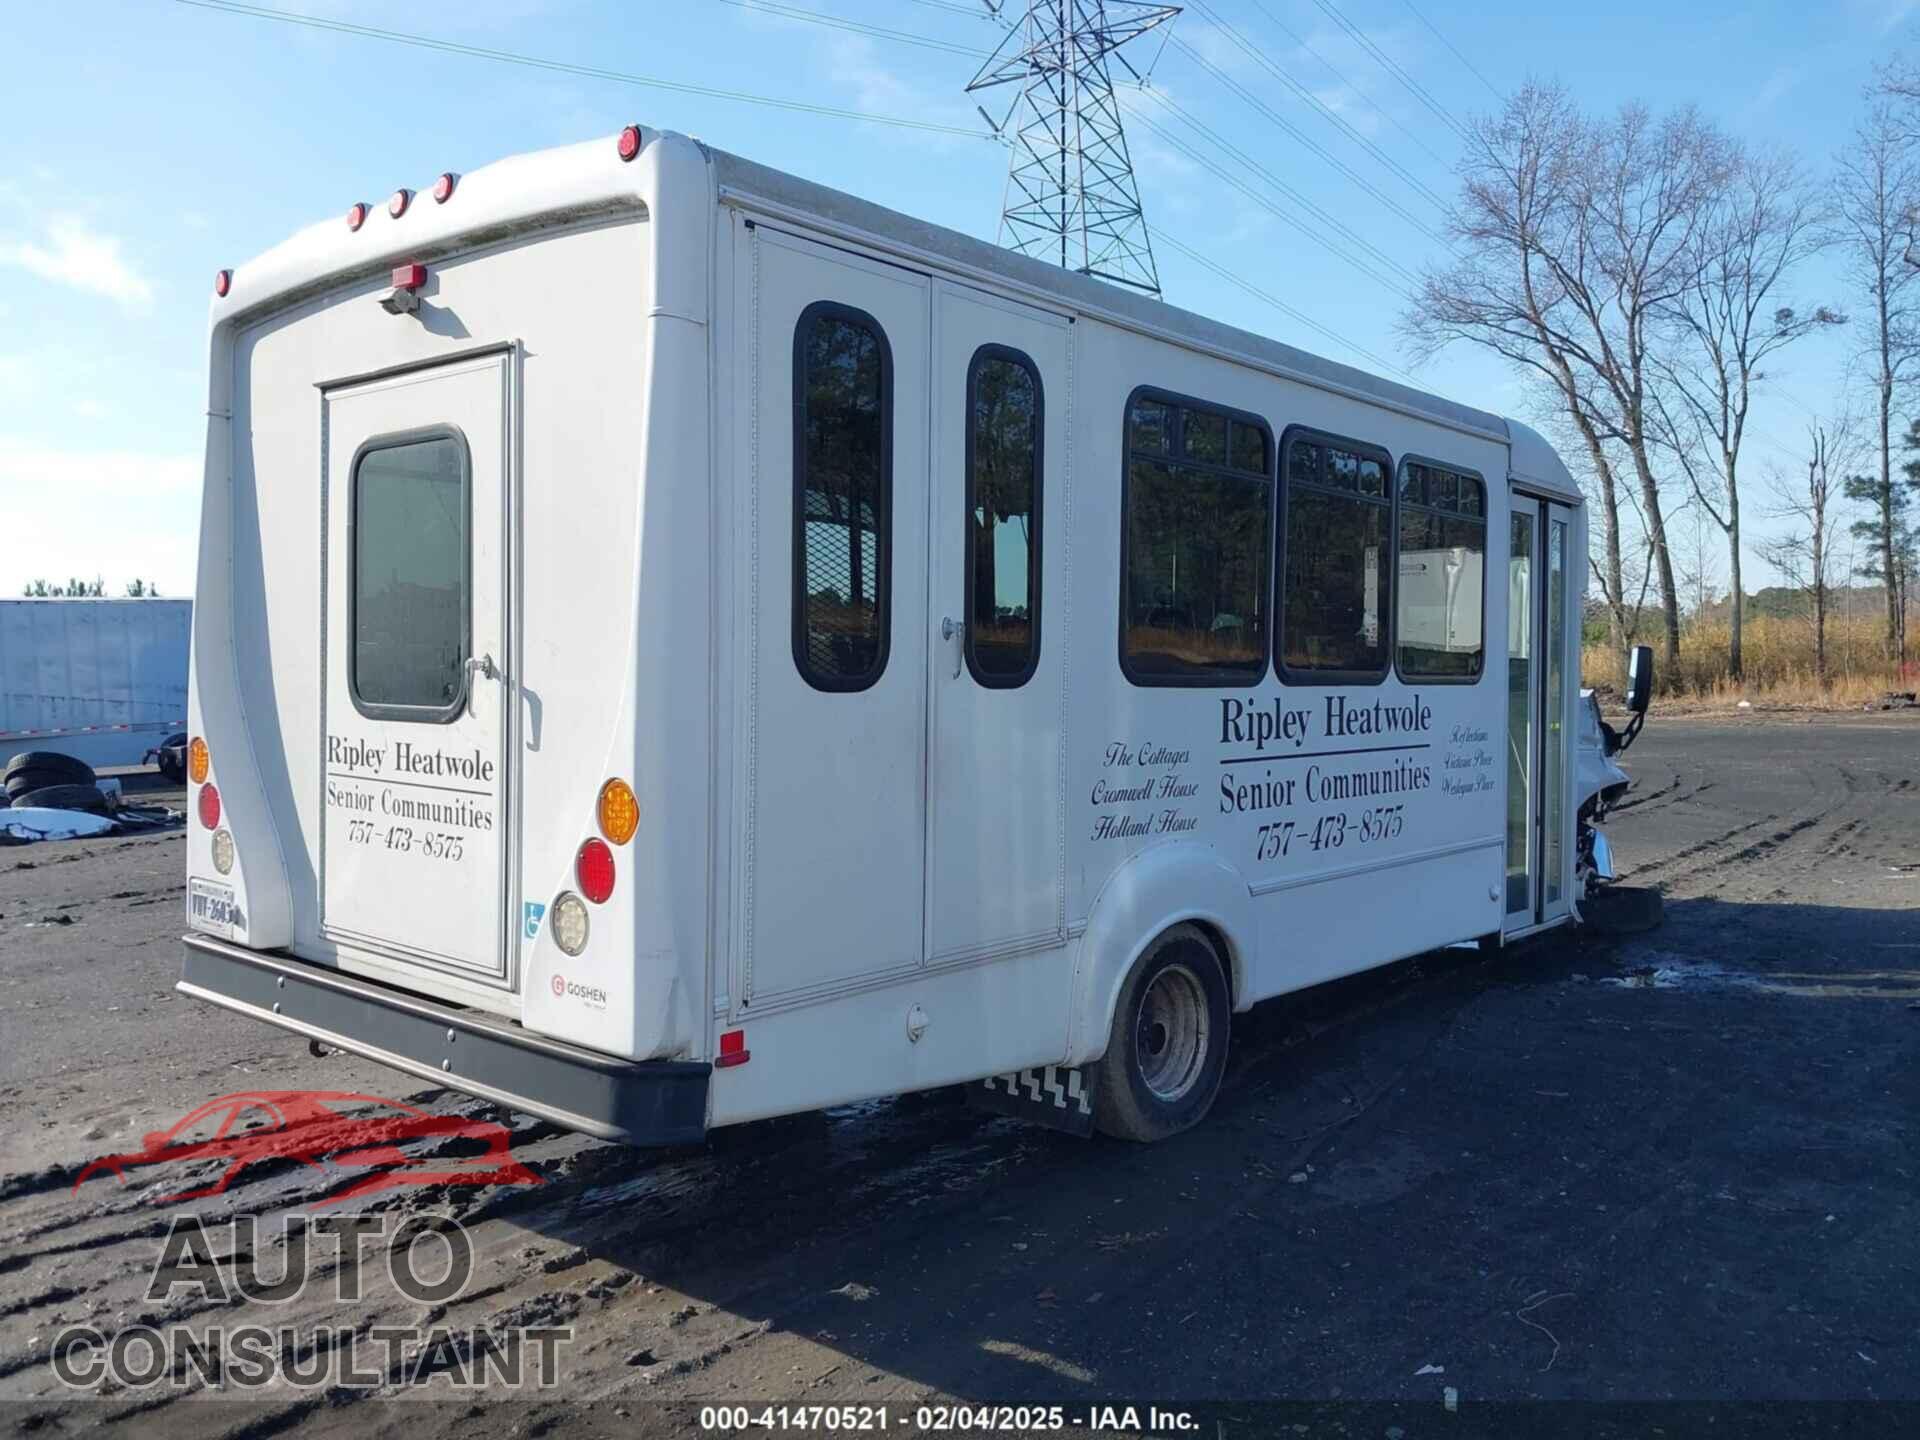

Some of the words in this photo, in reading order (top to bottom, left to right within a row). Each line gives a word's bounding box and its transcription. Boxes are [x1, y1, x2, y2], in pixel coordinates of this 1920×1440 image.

[1220, 697, 1312, 750] Ripley
[1324, 694, 1432, 737] Heatwole
[327, 735, 385, 773] Ripley
[395, 742, 494, 782] Heatwole
[1103, 742, 1133, 767] The
[1138, 742, 1190, 771] Cottages
[327, 781, 375, 813] Senior
[381, 788, 493, 831] Communities
[1091, 779, 1155, 805] Cromwell
[1156, 774, 1199, 800] House
[1220, 770, 1296, 814] Senior
[1306, 757, 1431, 804] Communities
[348, 819, 465, 862] 757-473-8575
[1091, 814, 1155, 841] Holland
[1155, 809, 1198, 833] House
[1257, 804, 1404, 861] 757-473-8575
[567, 982, 607, 1003] GOSHEN
